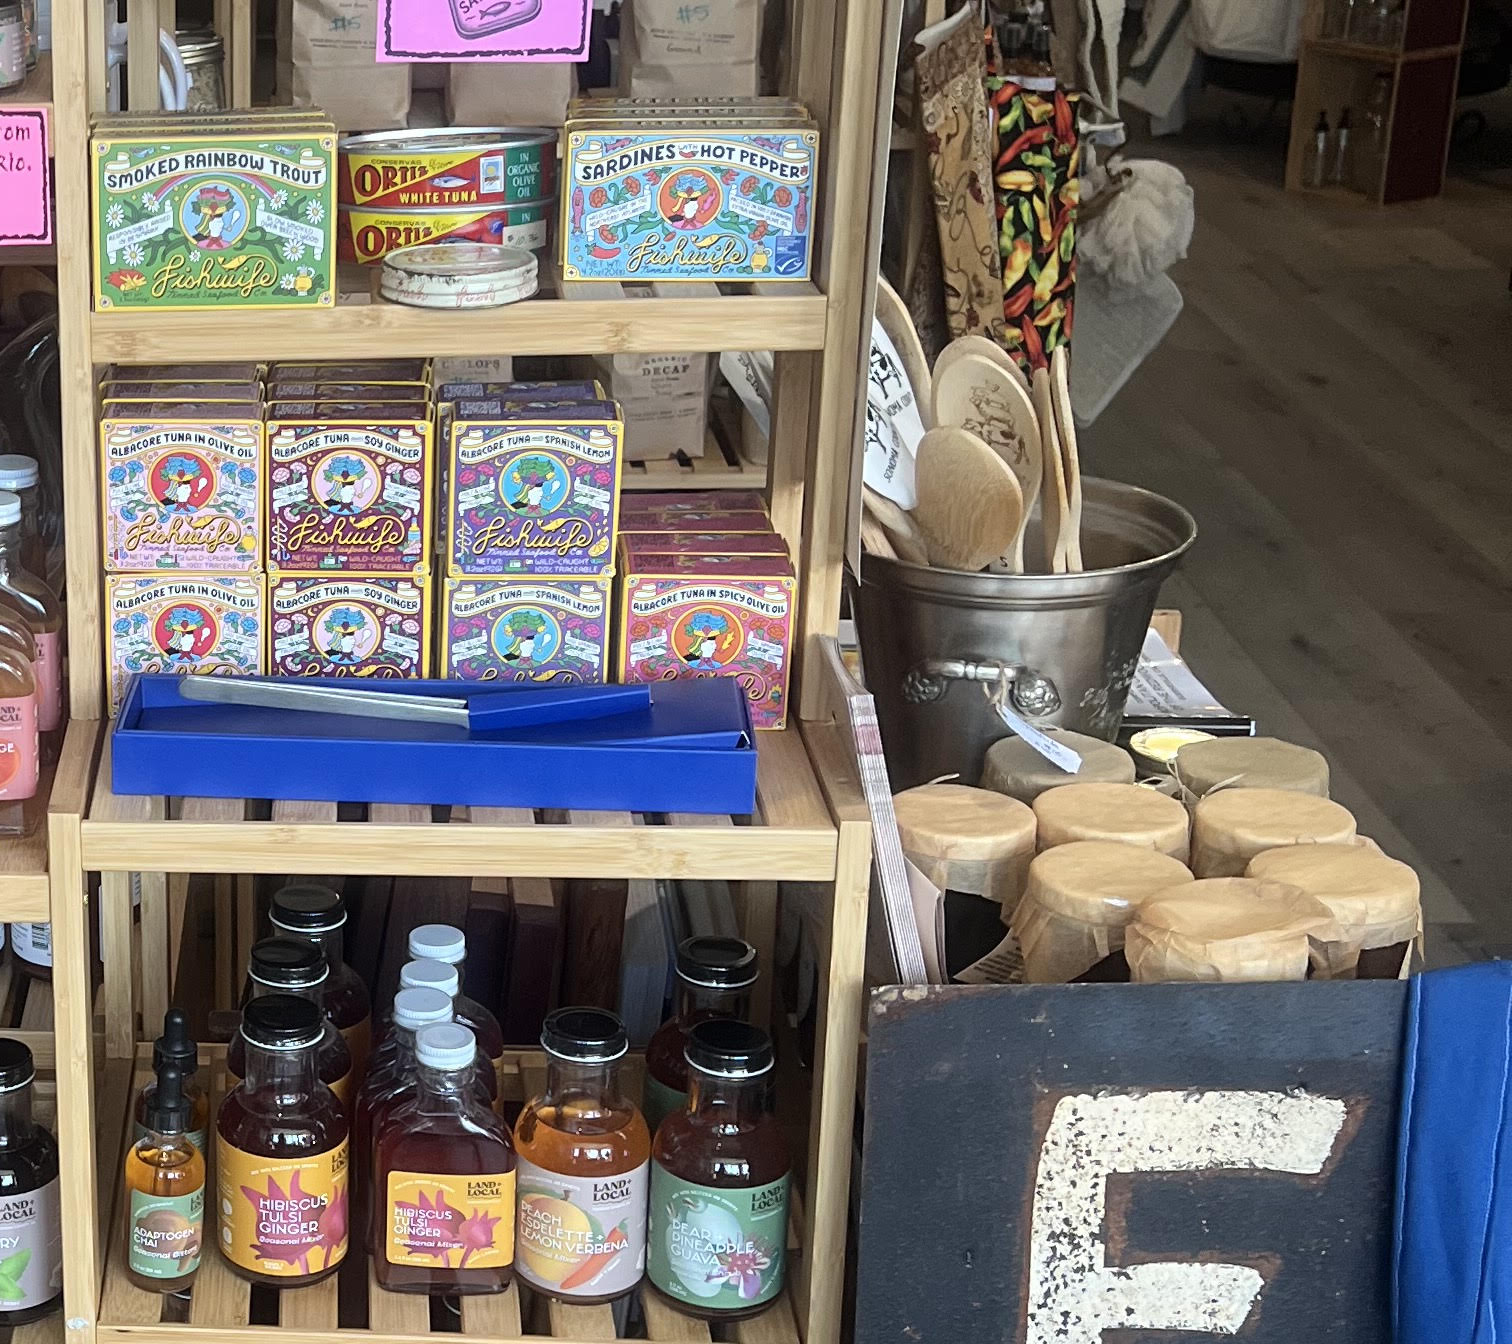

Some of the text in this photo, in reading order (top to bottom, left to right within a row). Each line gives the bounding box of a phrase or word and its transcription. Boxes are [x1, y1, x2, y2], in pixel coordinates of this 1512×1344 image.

[107, 152, 323, 189] SMOKED RAINBOW TROUT
[581, 142, 801, 181] SARDINES HOT PEPPER
[354, 164, 429, 198] ORTIZ
[399, 190, 478, 205] WHITE TUNA
[111, 432, 254, 459] ALBACORE TUNA IN OLIVE OIL
[258, 1192, 330, 1213] HIBISCUS
[258, 1208, 304, 1224] TULSI
[258, 1220, 320, 1237] GINGER
[519, 1227, 630, 1255] LEMON VERBENA
[669, 1242, 723, 1267] GUAVA
